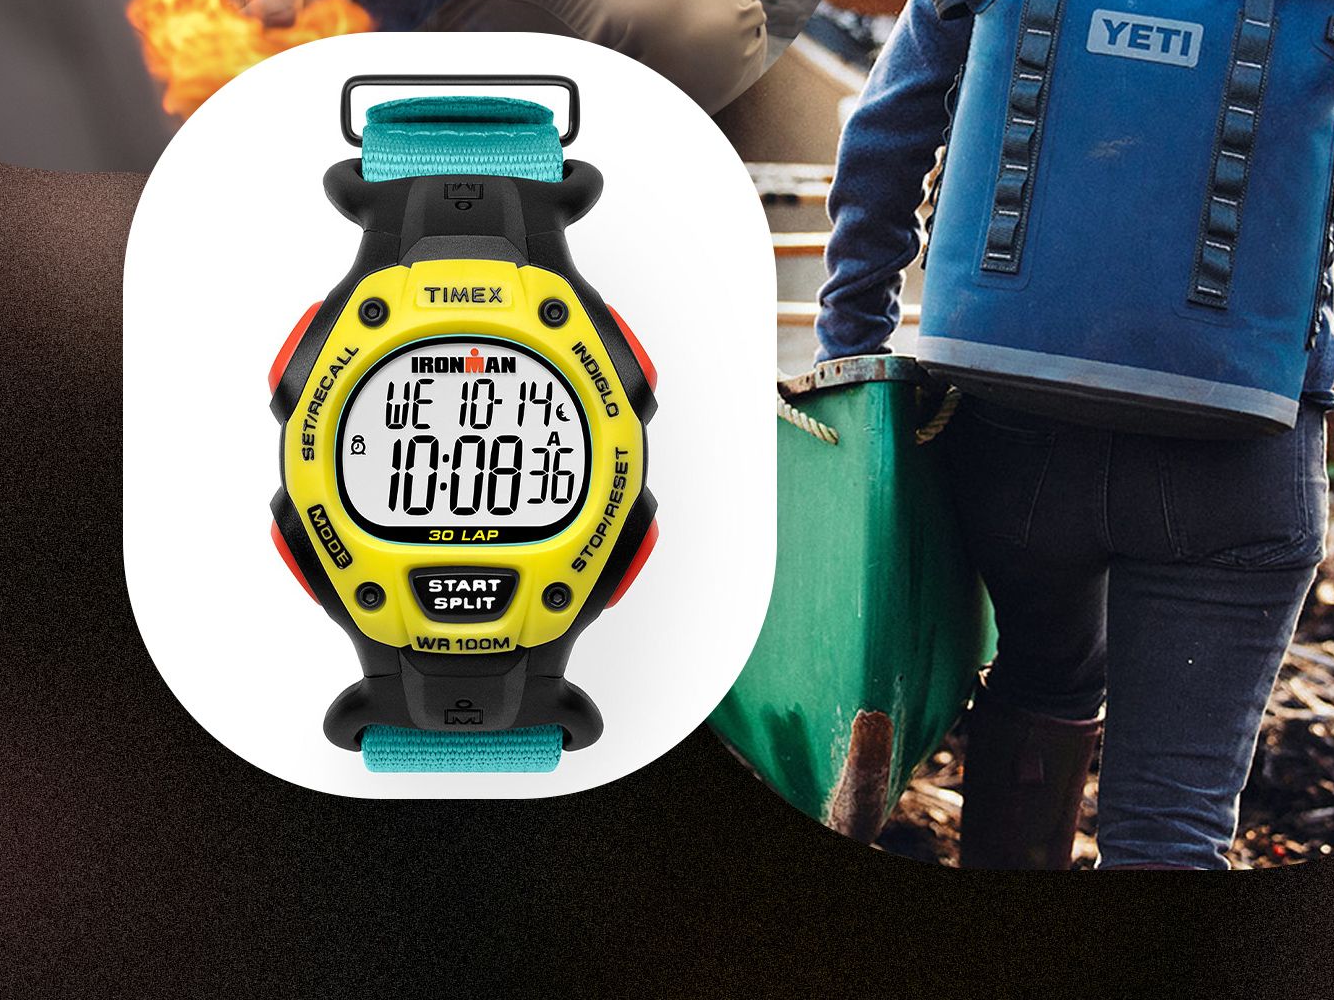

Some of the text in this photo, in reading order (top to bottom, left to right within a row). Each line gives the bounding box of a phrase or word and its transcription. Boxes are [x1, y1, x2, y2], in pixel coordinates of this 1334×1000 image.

[1101, 18, 1193, 57] YETI
[423, 286, 503, 303] TIMEX
[411, 348, 516, 374] IRONMAN
[571, 341, 619, 418] INDIGLO
[301, 344, 359, 461] SET/RECALL
[385, 378, 435, 430] WE
[387, 435, 575, 516] 10:08 36
[570, 446, 629, 573] STOP/RESET
[312, 508, 350, 568] MODE
[428, 529, 499, 542] 30 LAP
[428, 578, 501, 593] START
[433, 596, 496, 610] SPLIT
[416, 635, 510, 651] WR 100M
